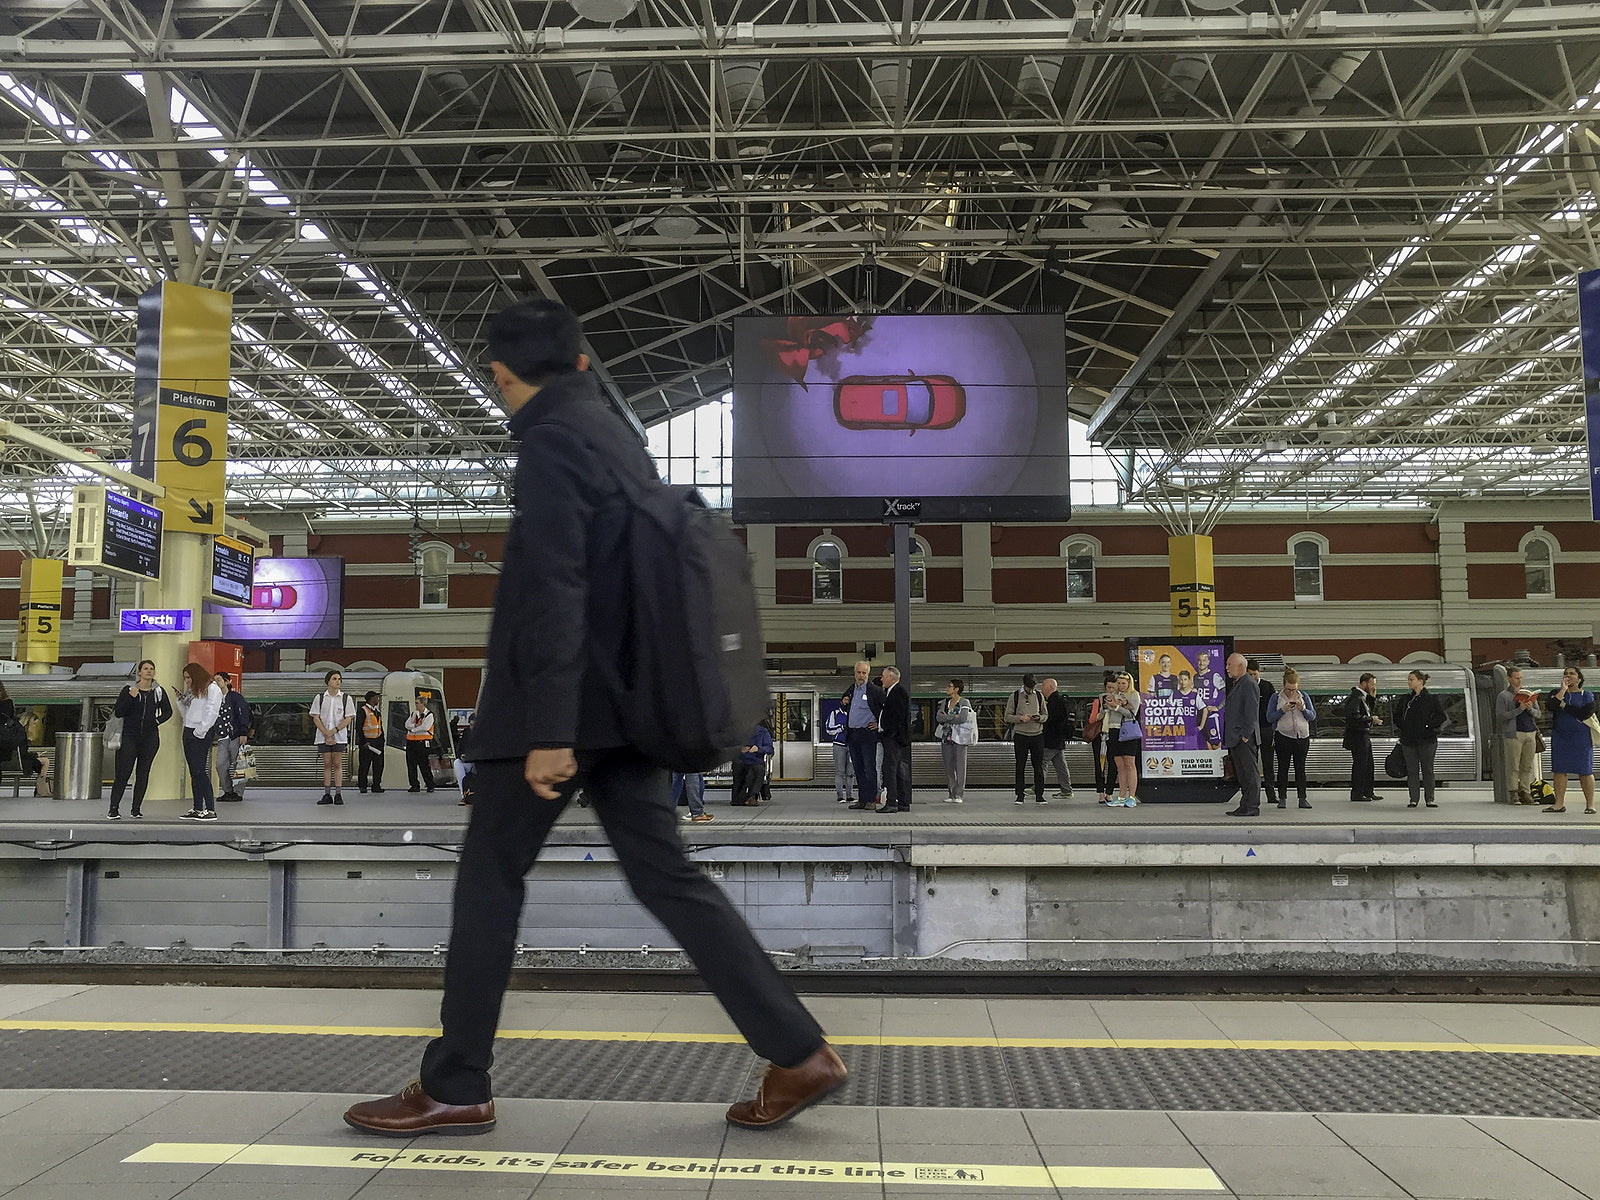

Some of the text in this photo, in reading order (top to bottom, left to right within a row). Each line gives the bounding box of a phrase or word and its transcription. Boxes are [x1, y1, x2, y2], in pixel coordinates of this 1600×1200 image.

[173, 392, 216, 407] Platform
[172, 418, 212, 467] 6
[107, 505, 129, 520] Fremantle
[141, 517, 144, 526] 3
[1178, 598, 1191, 618] 5
[1203, 598, 1211, 618] 5
[21, 616, 27, 634] 5
[37, 615, 52, 634] 5
[140, 614, 173, 625] Perth
[1145, 706, 1183, 716] GOTTA
[1145, 716, 1185, 726] HAVE A
[1146, 725, 1186, 737] TEAM
[351, 1152, 906, 1178] For kids, it's safer behind this line
